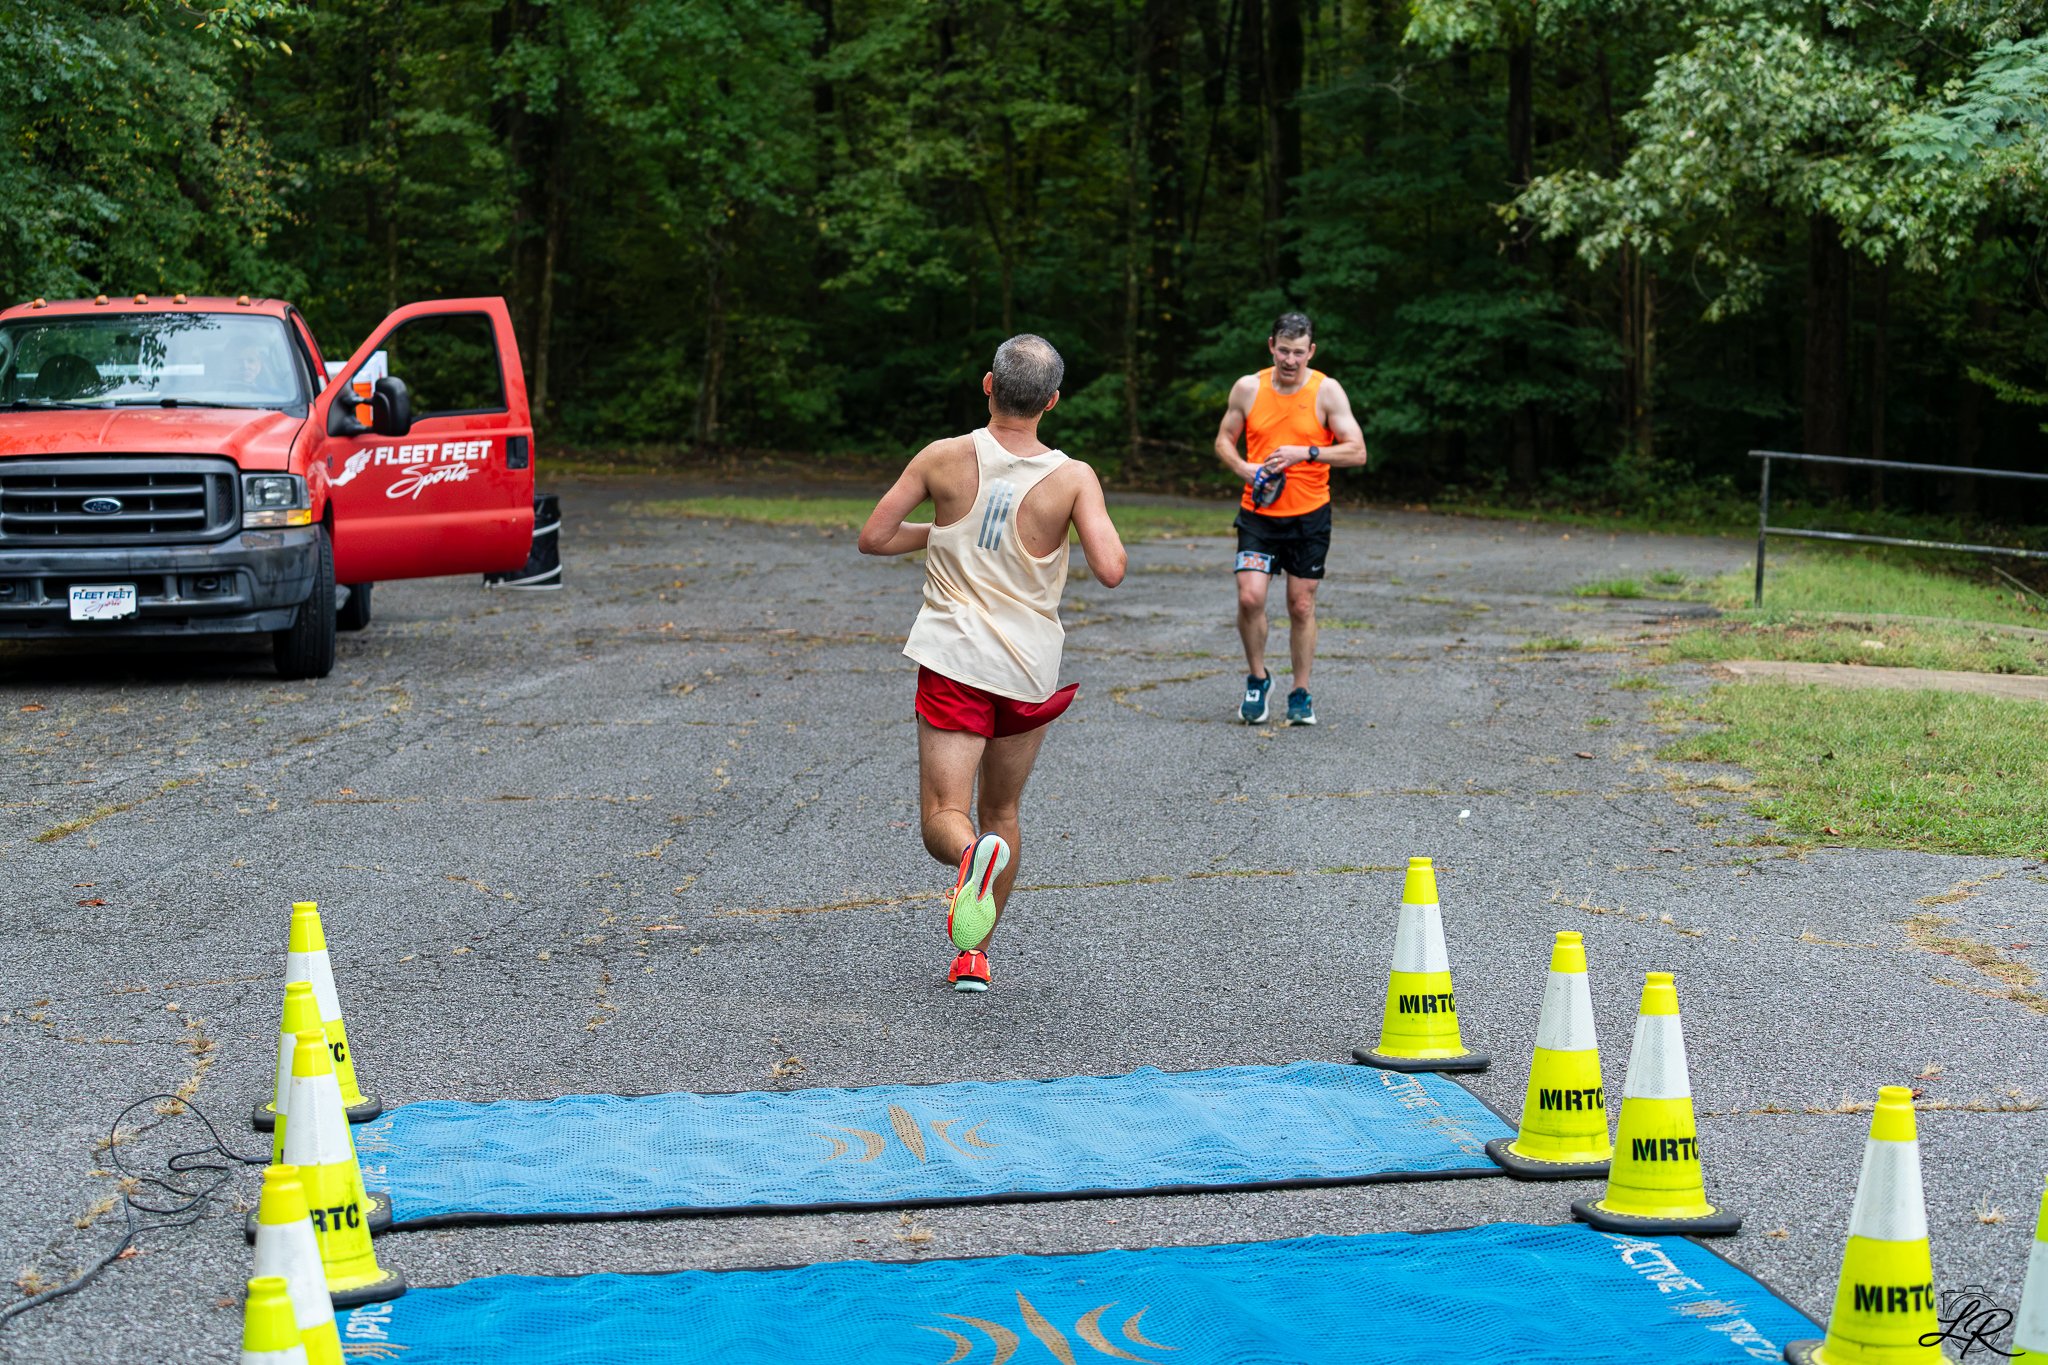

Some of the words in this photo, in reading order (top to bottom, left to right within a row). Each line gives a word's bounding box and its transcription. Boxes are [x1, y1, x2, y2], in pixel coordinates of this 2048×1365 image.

[374, 443, 438, 466] FLEET
[440, 440, 493, 462] FEET
[386, 461, 480, 500] Sports
[73, 591, 104, 600] FLEET
[106, 590, 133, 599] FEET
[1399, 993, 1456, 1014] MRTC
[1540, 1086, 1604, 1111] MRTC
[1632, 1136, 1699, 1162] MRTC
[309, 1202, 360, 1233] RTC
